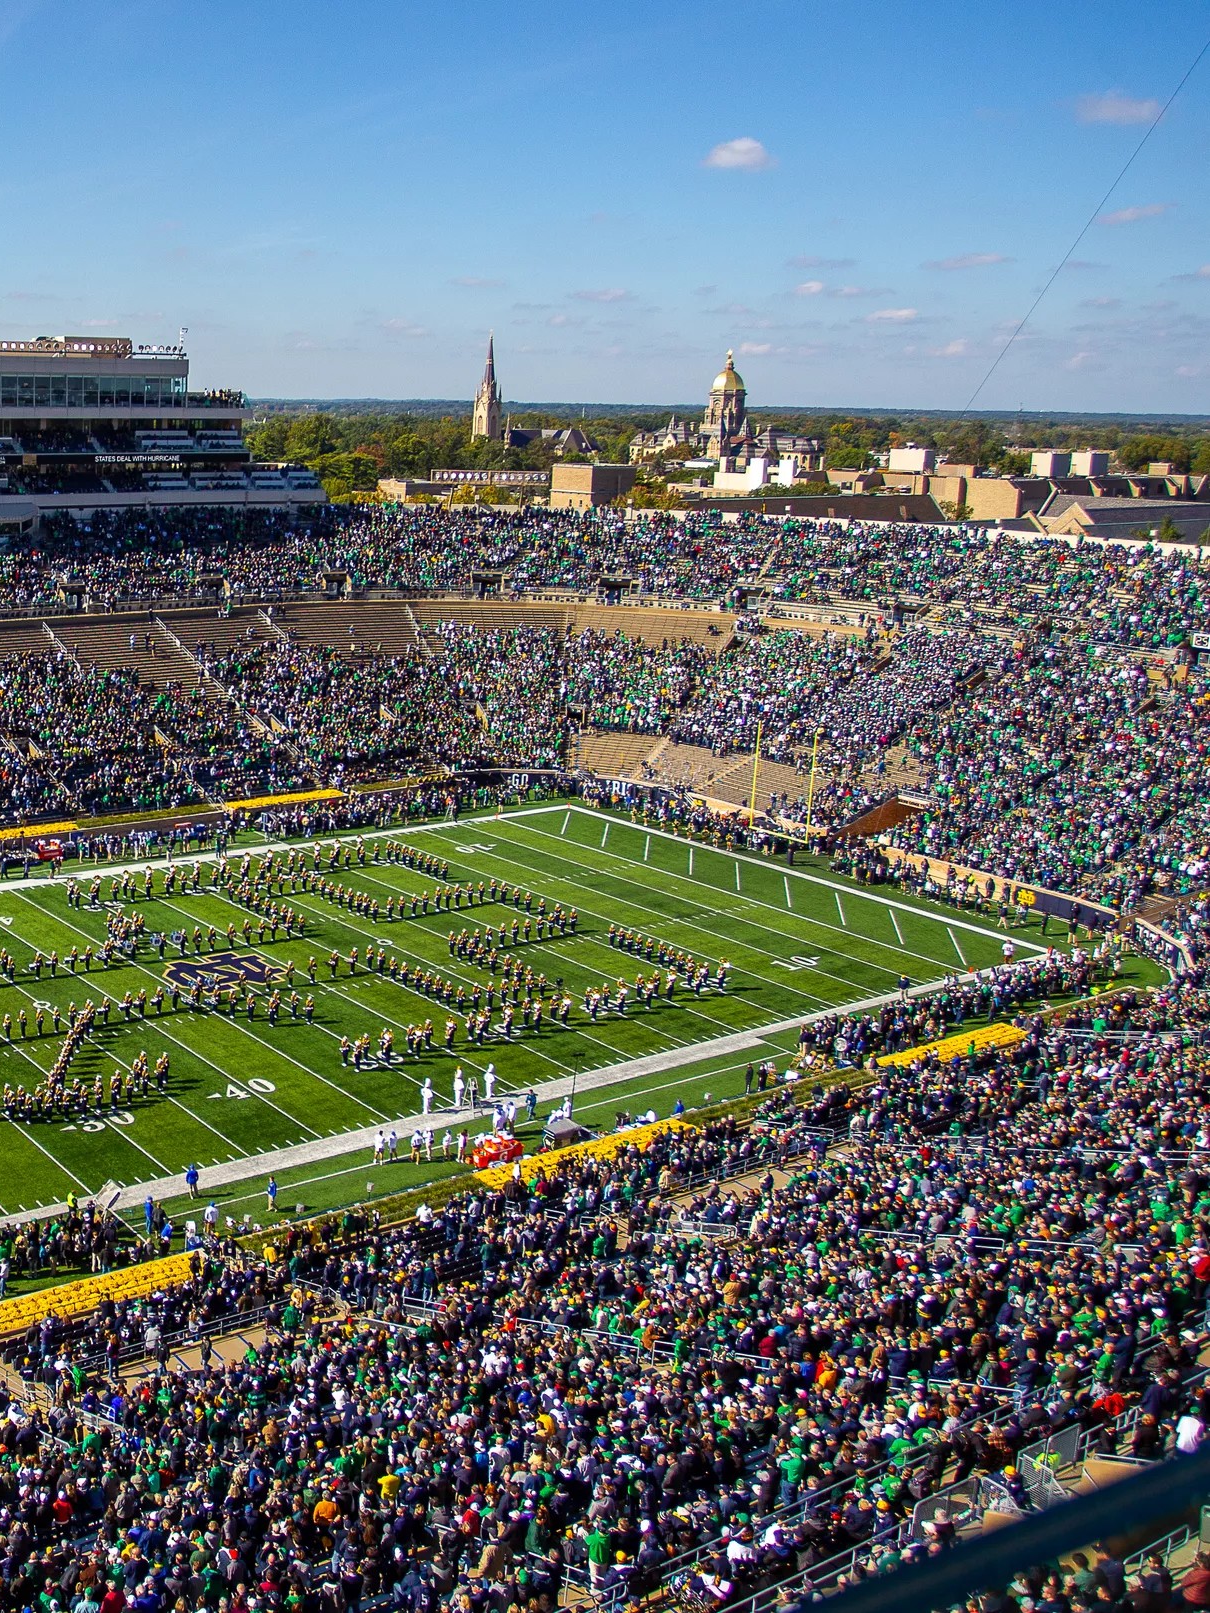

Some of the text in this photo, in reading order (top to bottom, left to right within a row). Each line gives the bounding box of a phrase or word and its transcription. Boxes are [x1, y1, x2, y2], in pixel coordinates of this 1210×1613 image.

[512, 773, 529, 787] GO
[226, 1078, 276, 1100] 40
[421, 1593, 428, 1606] 5
